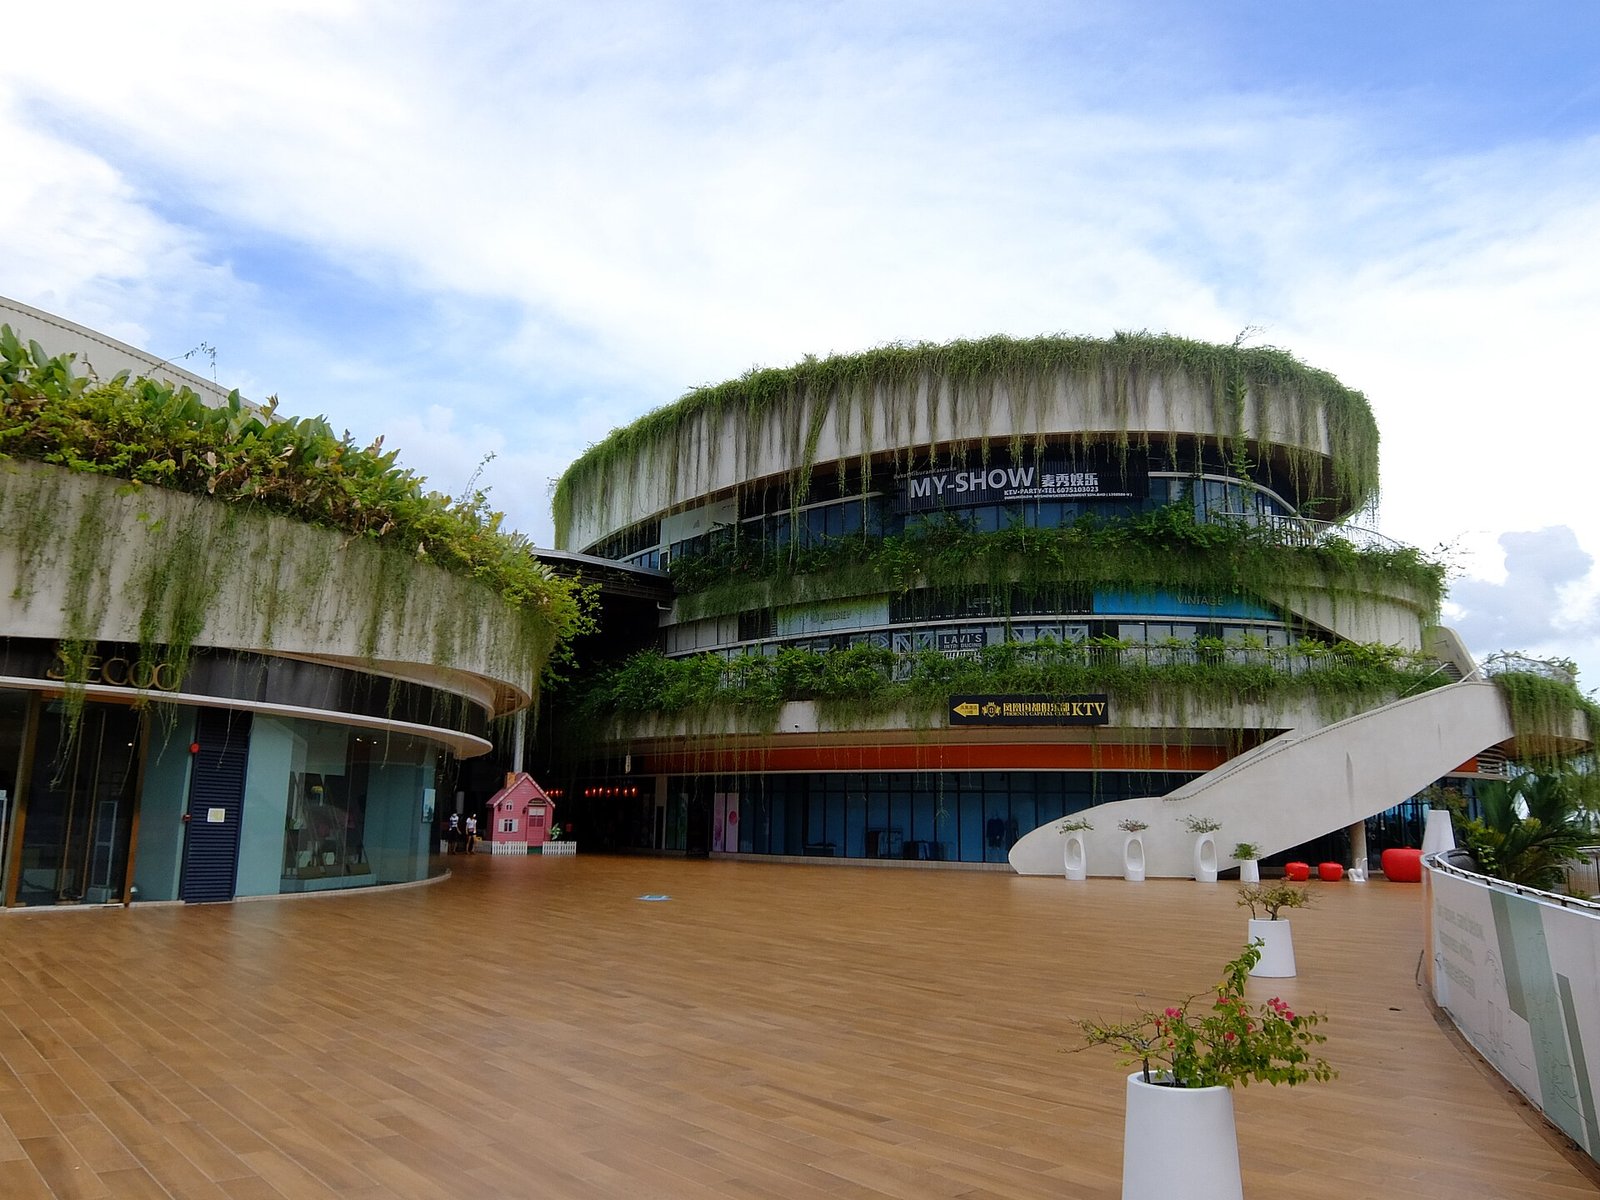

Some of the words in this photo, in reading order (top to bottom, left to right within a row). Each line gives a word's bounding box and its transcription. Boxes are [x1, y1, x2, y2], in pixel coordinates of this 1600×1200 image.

[911, 467, 1035, 498] MY-SHOW
[1176, 594, 1223, 606] VINTAGE
[944, 634, 982, 644] LAVI'S
[1071, 702, 1105, 716] KTV
